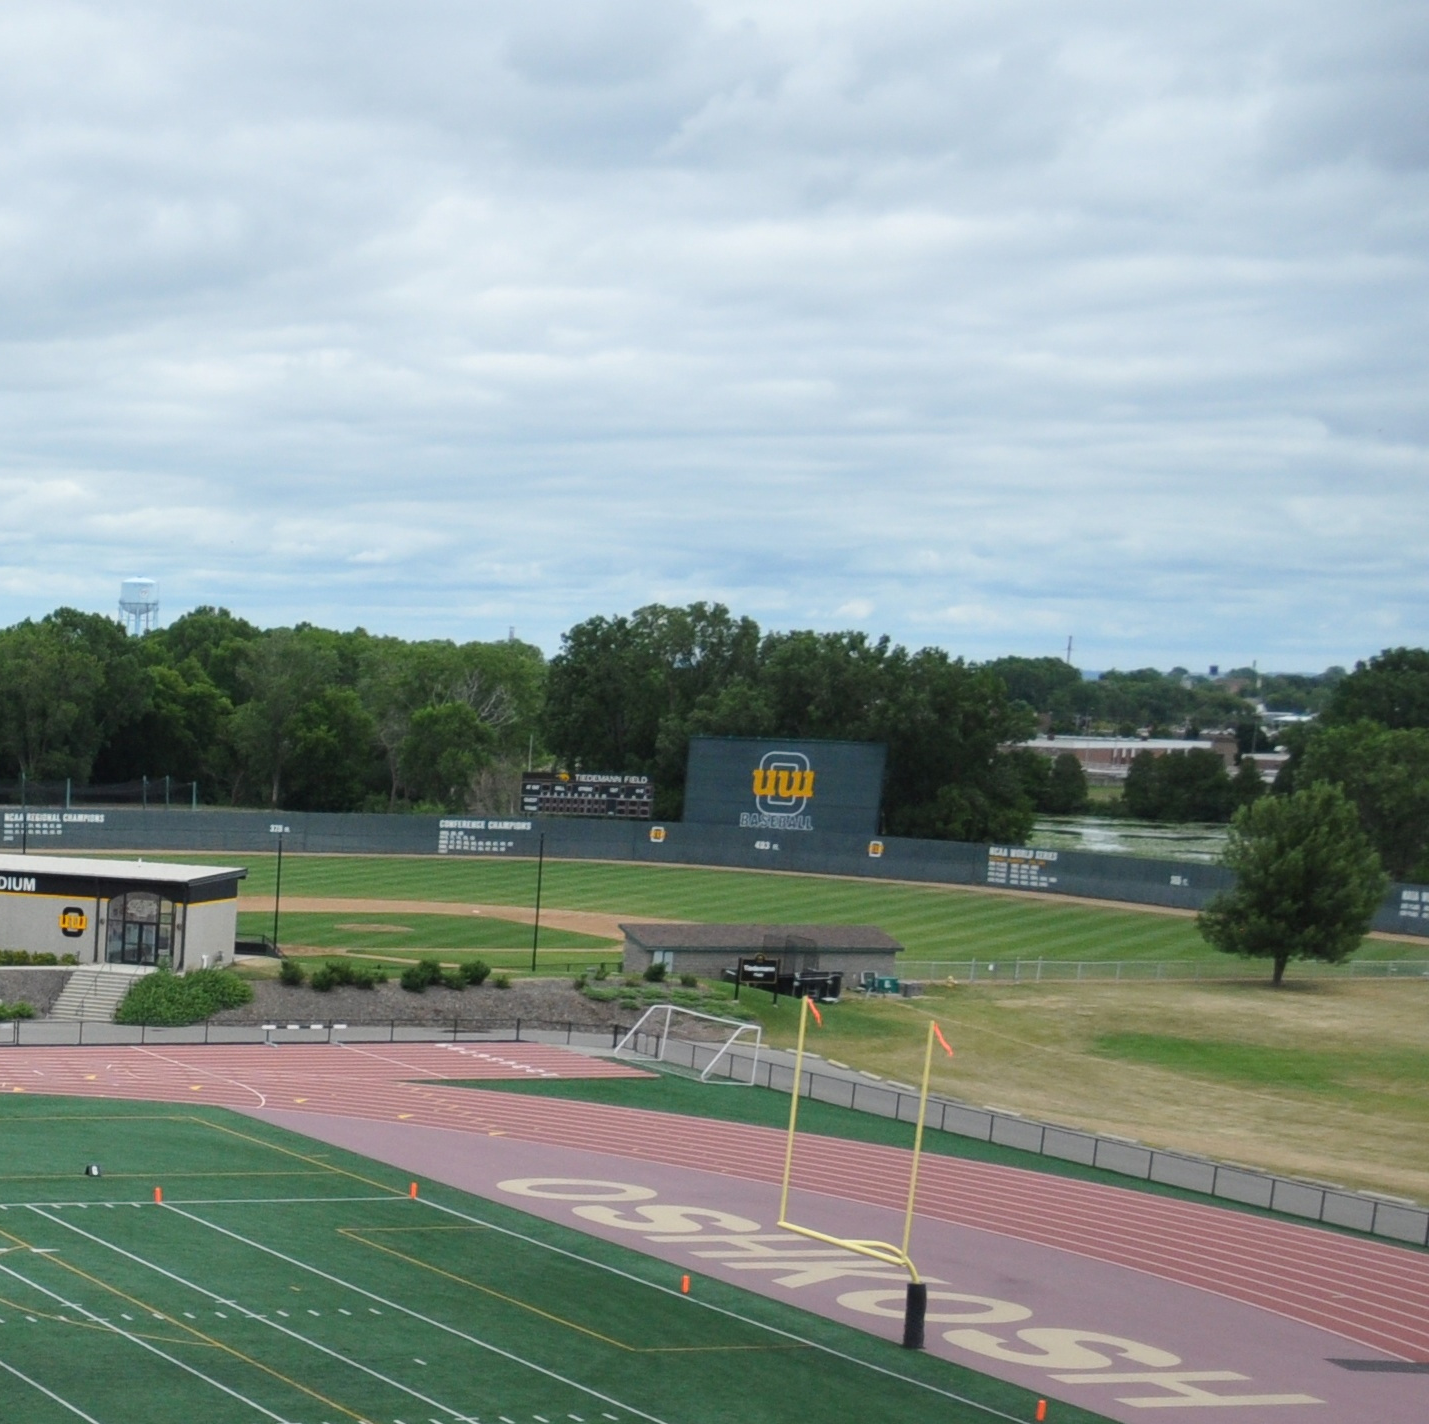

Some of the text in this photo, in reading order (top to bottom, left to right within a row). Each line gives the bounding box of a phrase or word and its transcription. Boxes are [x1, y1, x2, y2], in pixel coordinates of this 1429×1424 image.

[575, 774, 648, 784] TIEDEMANN FIELD
[4, 813, 24, 822] NCAA
[62, 814, 105, 823] CHAMPIONS
[740, 813, 814, 831] BASEBALL
[439, 820, 532, 831] CONFERENCE CHAMPIONS
[496, 1176, 1329, 1409] OSHKOSH
